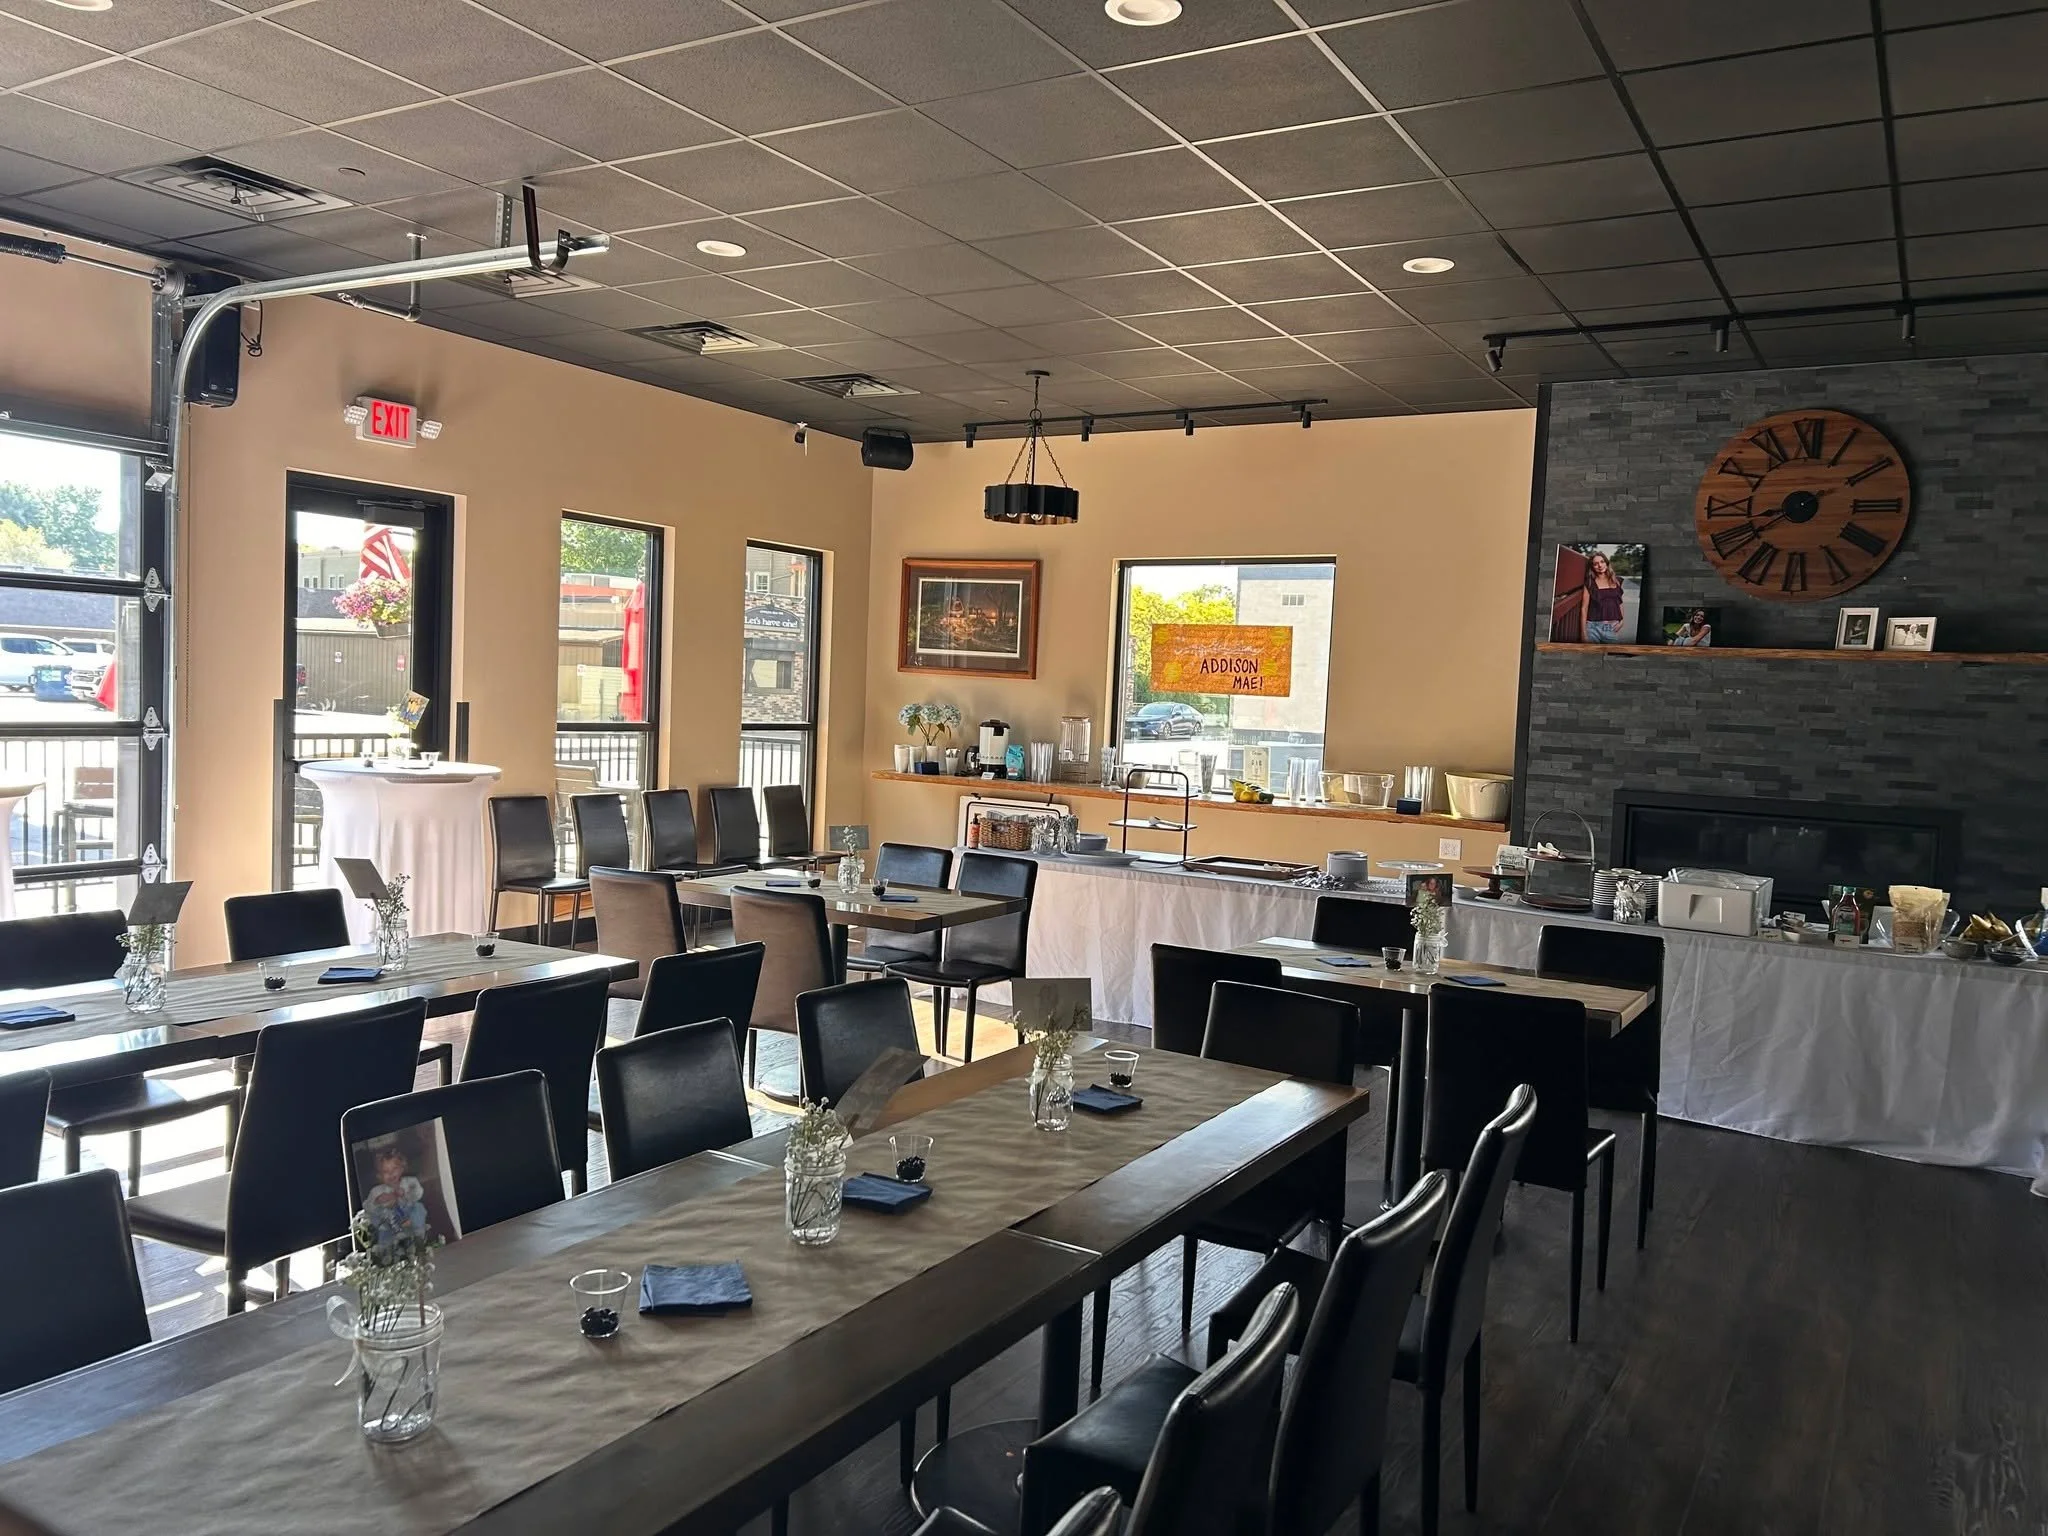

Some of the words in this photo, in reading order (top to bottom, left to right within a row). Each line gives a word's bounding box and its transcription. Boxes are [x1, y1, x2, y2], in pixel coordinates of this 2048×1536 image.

[371, 400, 411, 440] EXIT
[1200, 658, 1258, 674] ADDISON
[1232, 676, 1263, 690] MAE!
